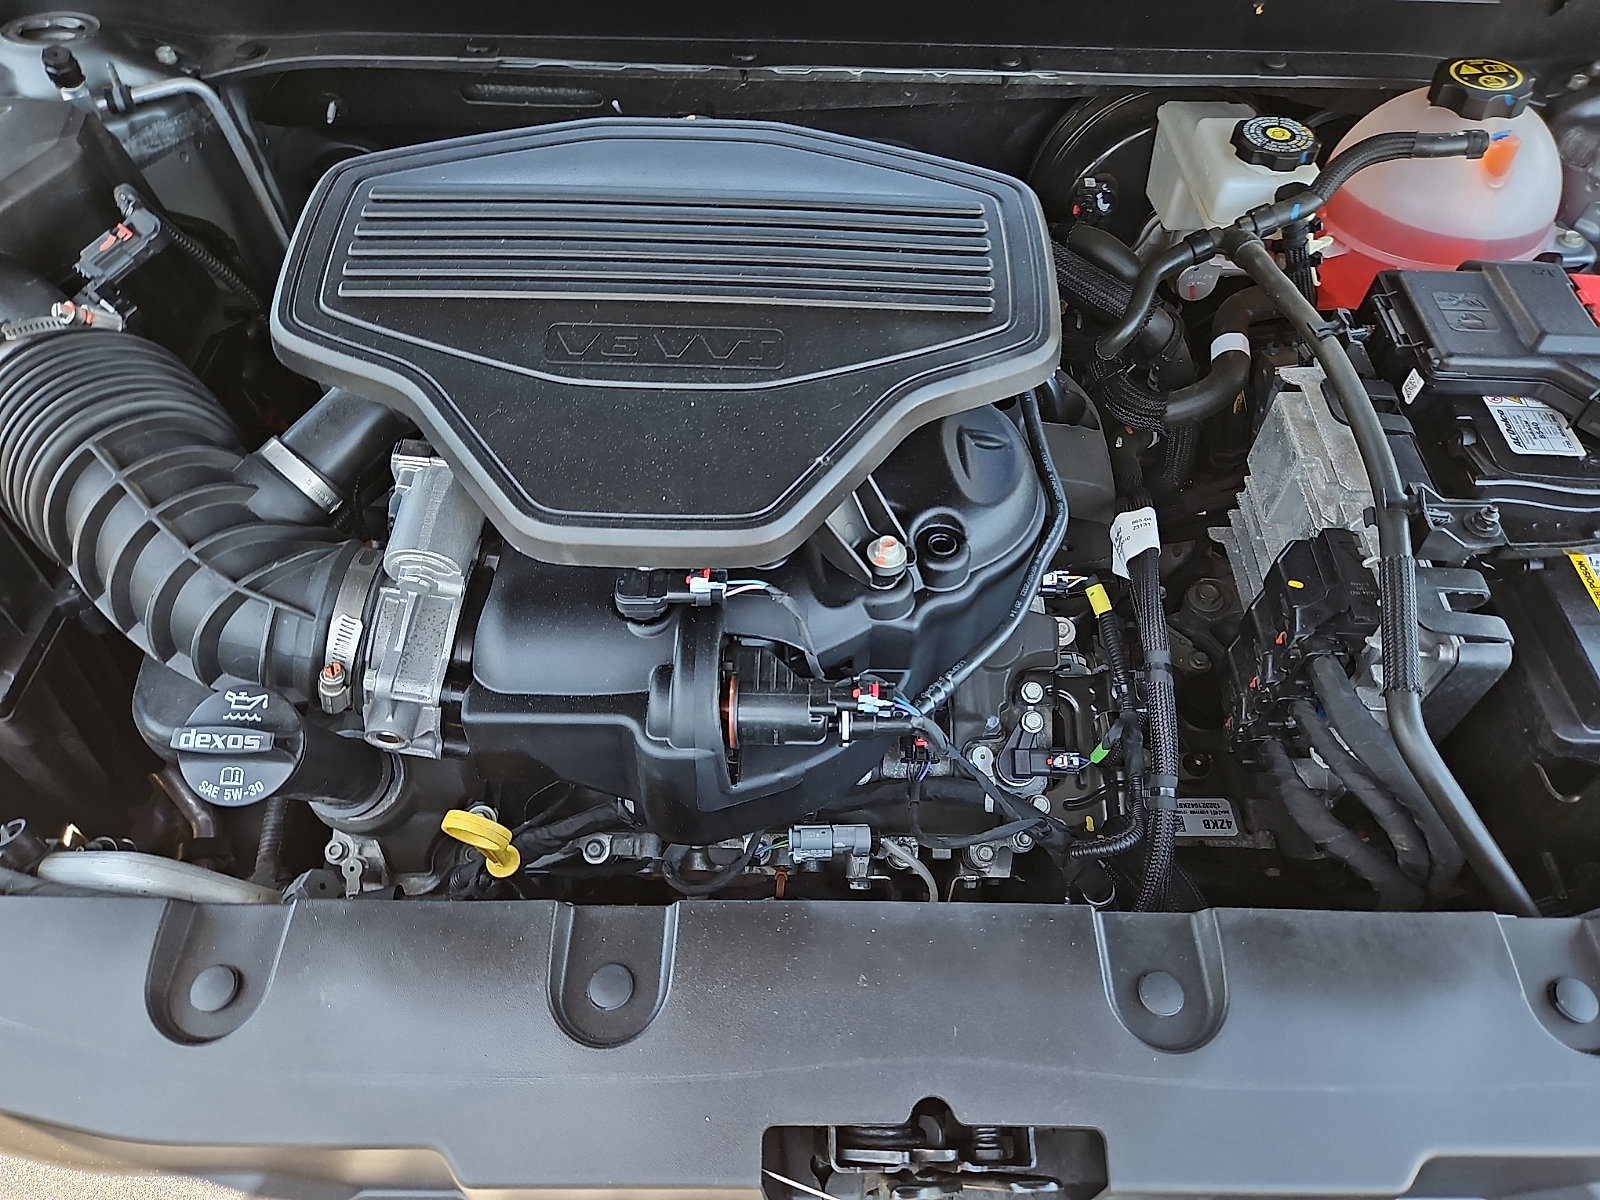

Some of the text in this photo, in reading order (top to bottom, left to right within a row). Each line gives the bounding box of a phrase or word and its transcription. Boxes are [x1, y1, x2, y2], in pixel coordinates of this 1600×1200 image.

[557, 330, 642, 357] V6
[1496, 408, 1525, 449] ACDelco
[180, 728, 261, 750] dexos
[198, 780, 264, 801] SAE 5W-30
[1202, 818, 1233, 830] 4ZKB
